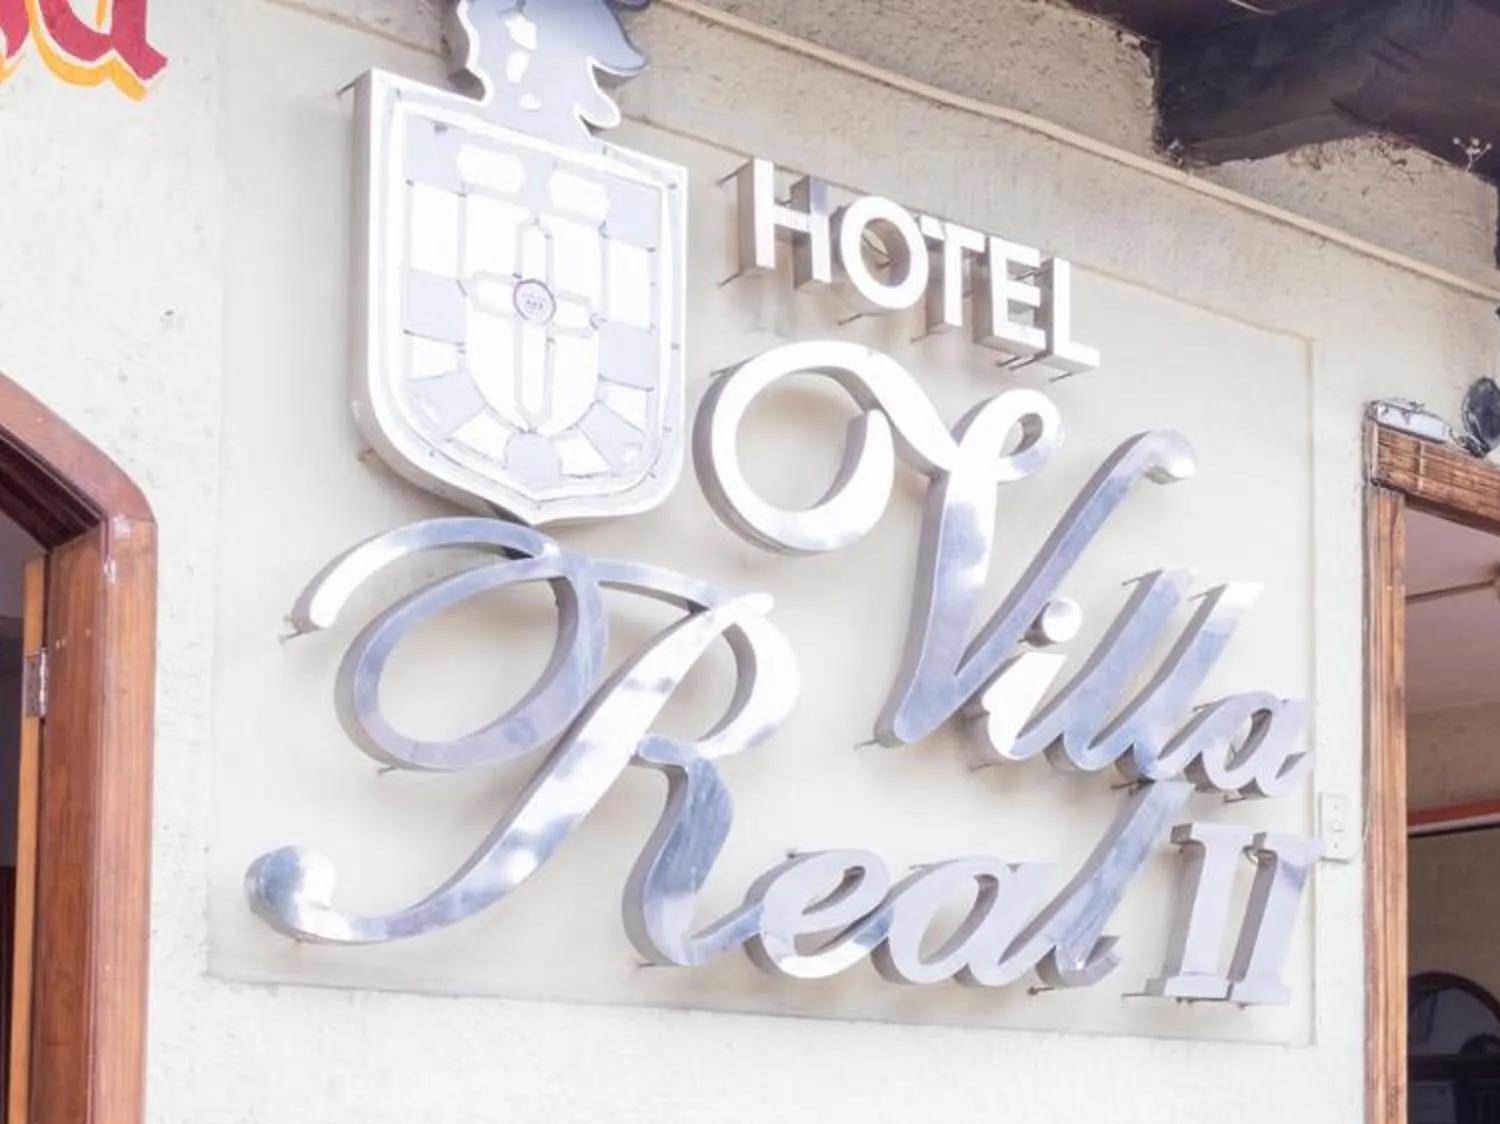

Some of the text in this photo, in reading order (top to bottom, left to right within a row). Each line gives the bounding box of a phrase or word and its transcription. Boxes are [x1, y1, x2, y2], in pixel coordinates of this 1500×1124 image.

[740, 158, 1101, 372] HOTEL
[245, 517, 1323, 1002] Real II
[694, 341, 1316, 796] Villa
